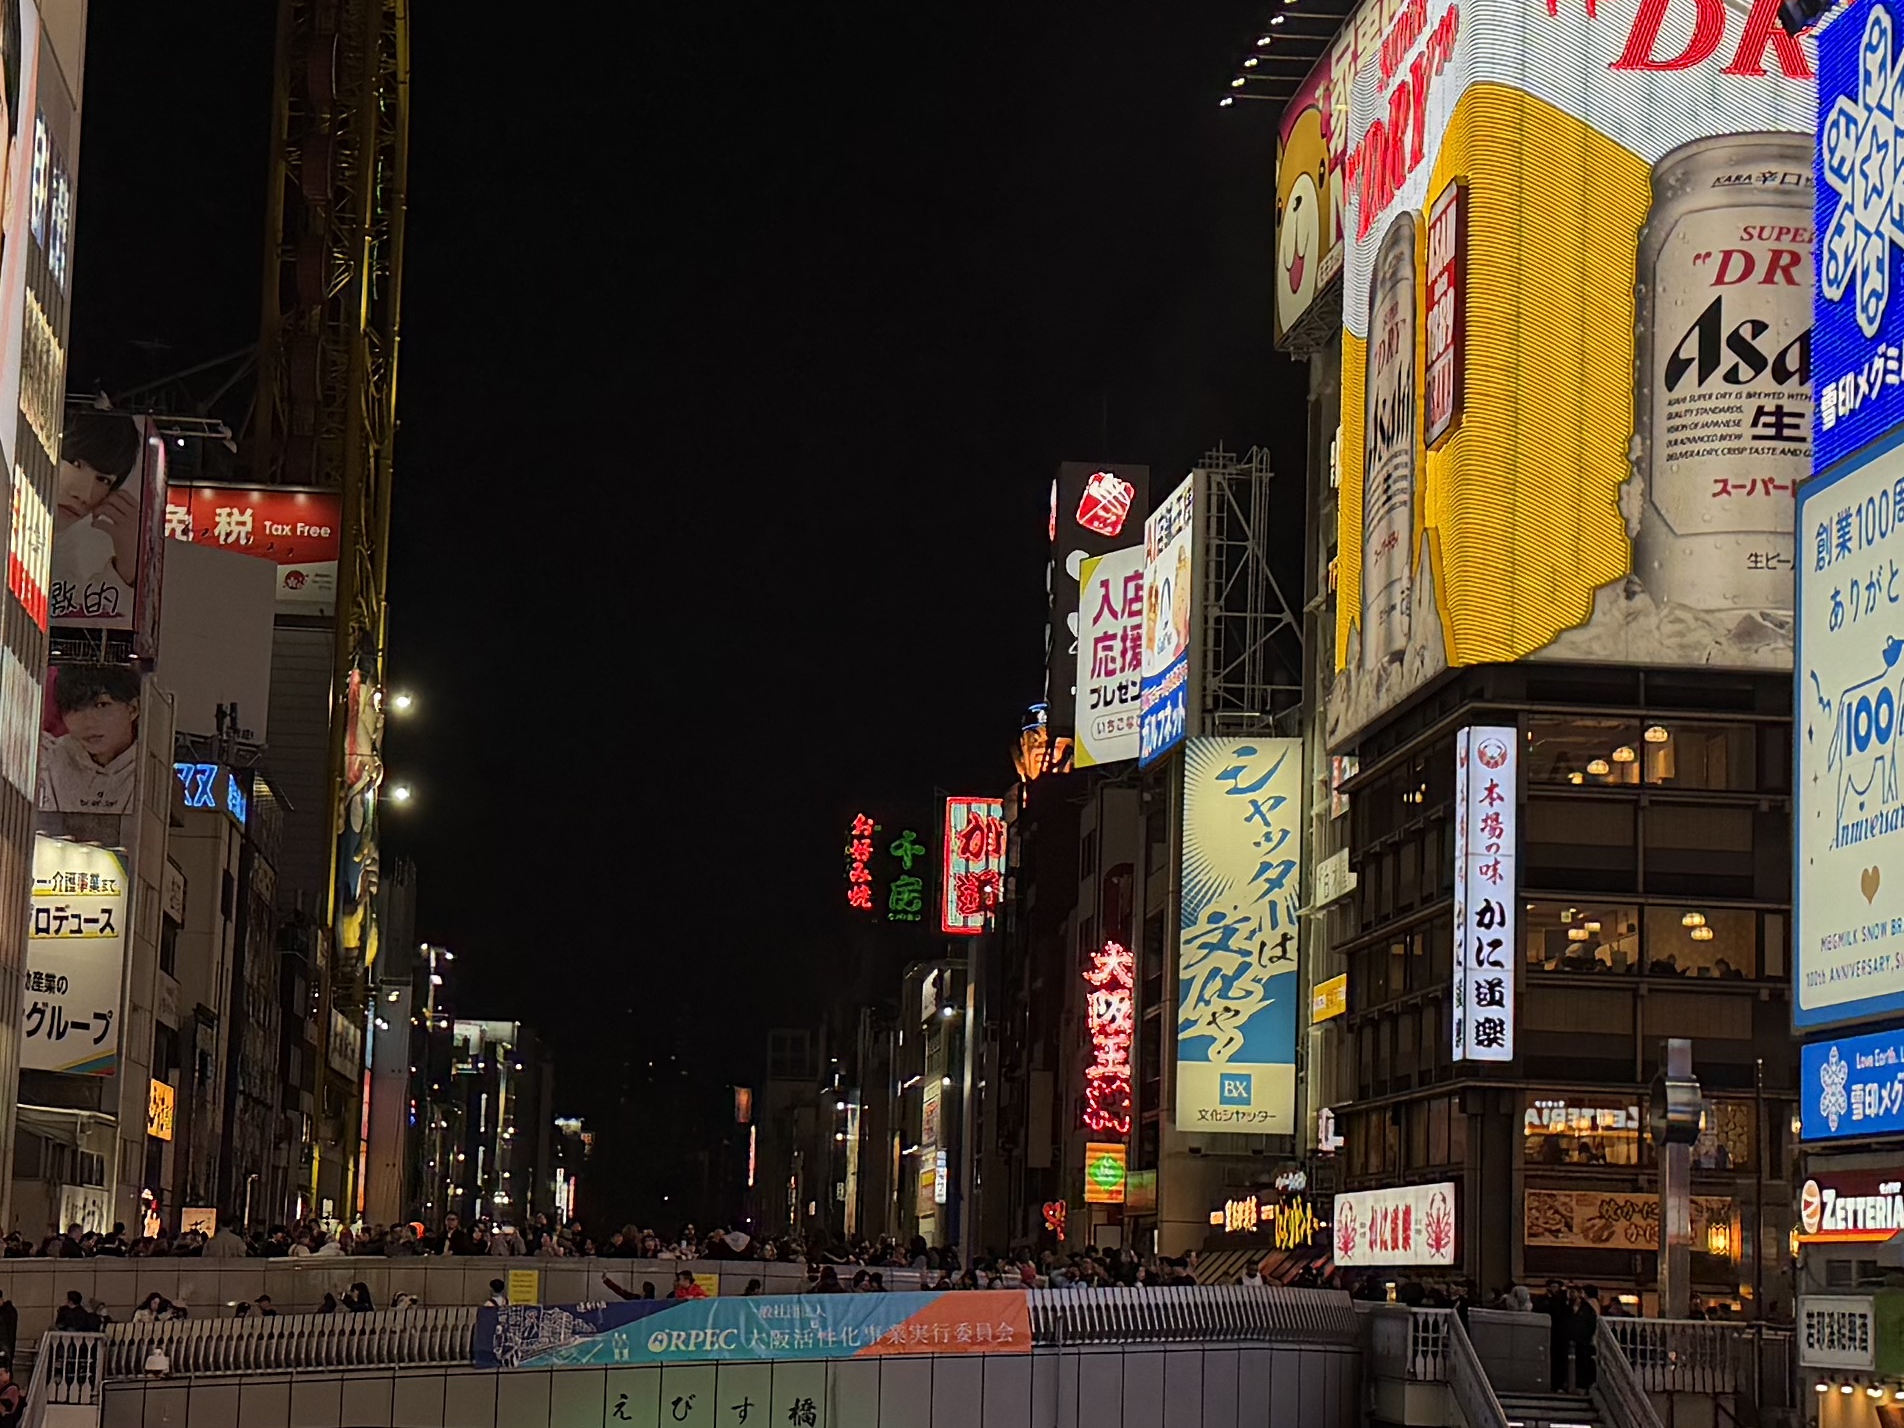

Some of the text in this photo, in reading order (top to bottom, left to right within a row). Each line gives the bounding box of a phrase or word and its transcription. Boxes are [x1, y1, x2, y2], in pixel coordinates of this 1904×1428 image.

[1749, 404, 1808, 443] 生
[262, 519, 332, 539] Tax Free
[1478, 777, 1505, 886] 本場の味
[1474, 898, 1507, 1049] かに道楽
[1223, 1080, 1249, 1098] BX
[1196, 1108, 1277, 1124] 文化シャッター
[611, 1393, 819, 1428] えびす橋
